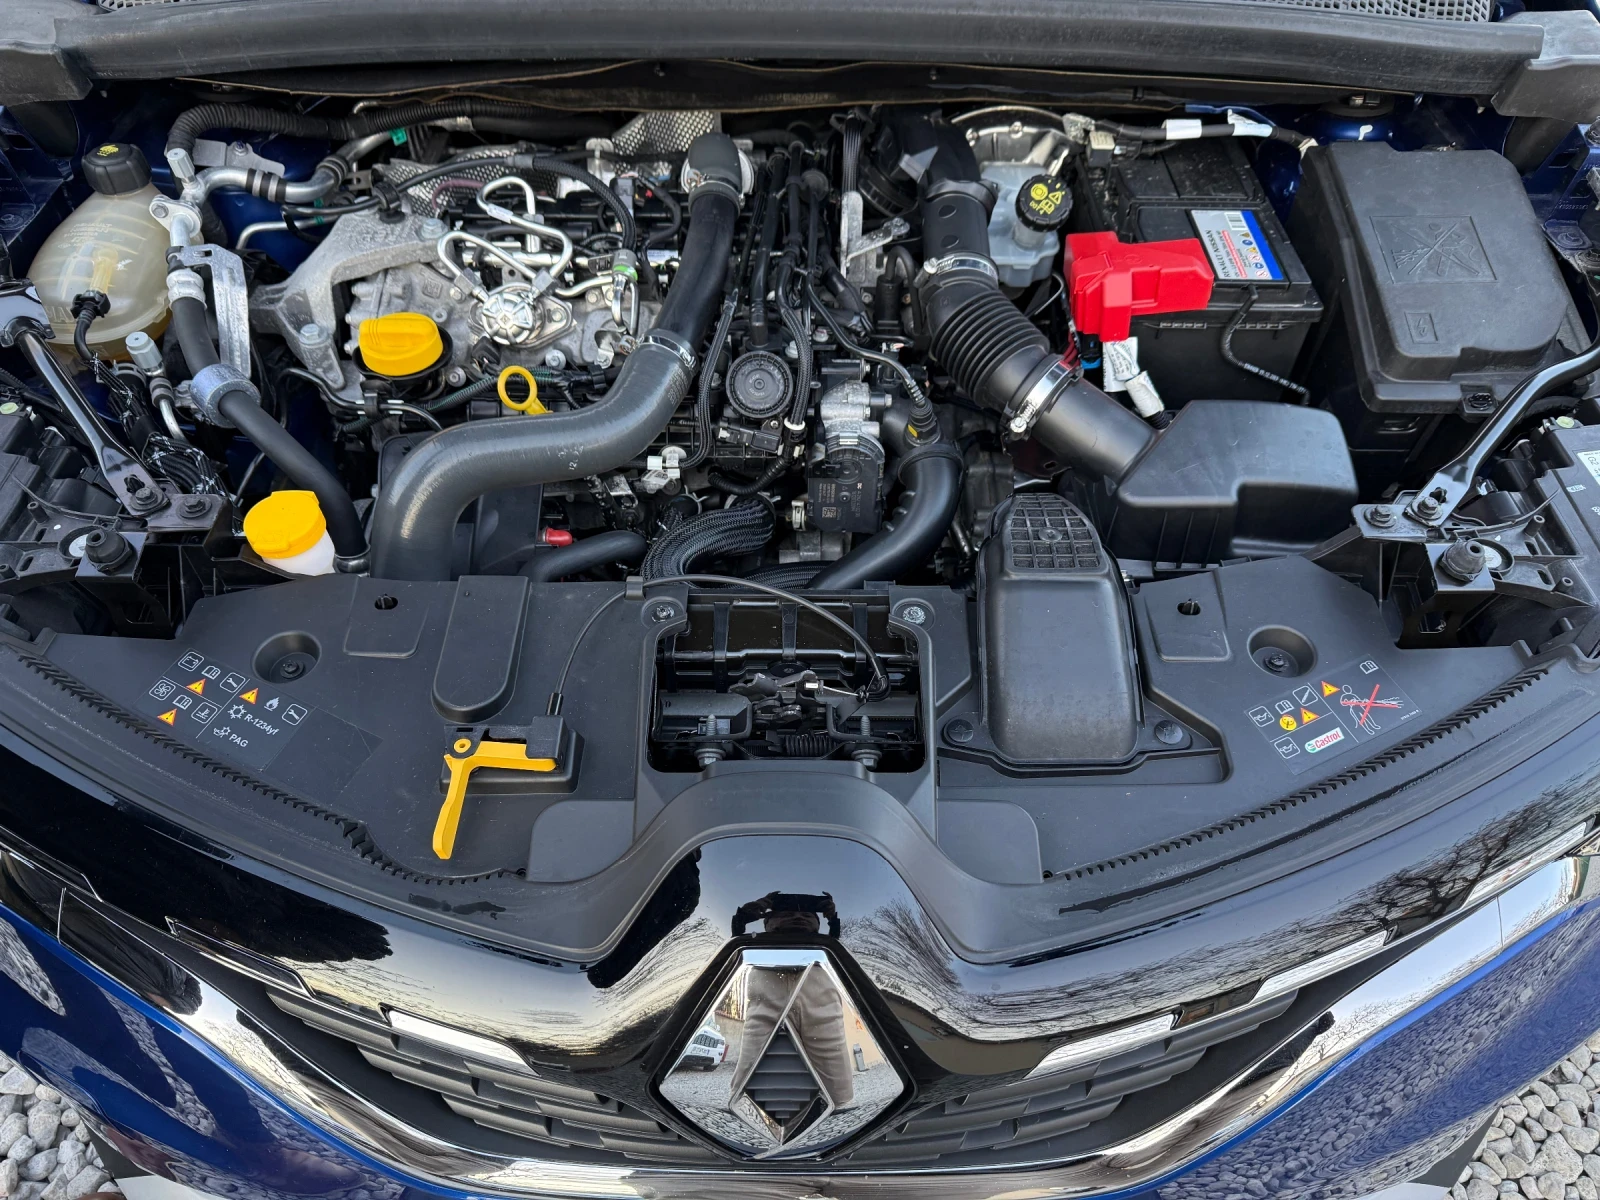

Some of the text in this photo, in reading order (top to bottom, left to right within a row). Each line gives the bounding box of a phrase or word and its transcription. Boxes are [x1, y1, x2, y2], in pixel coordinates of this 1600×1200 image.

[1205, 230, 1220, 253] NISSAN
[1216, 254, 1231, 278] RENAULT
[244, 714, 279, 735] R-1234yf
[229, 733, 249, 748] PAG
[1314, 730, 1341, 749] Castrol
